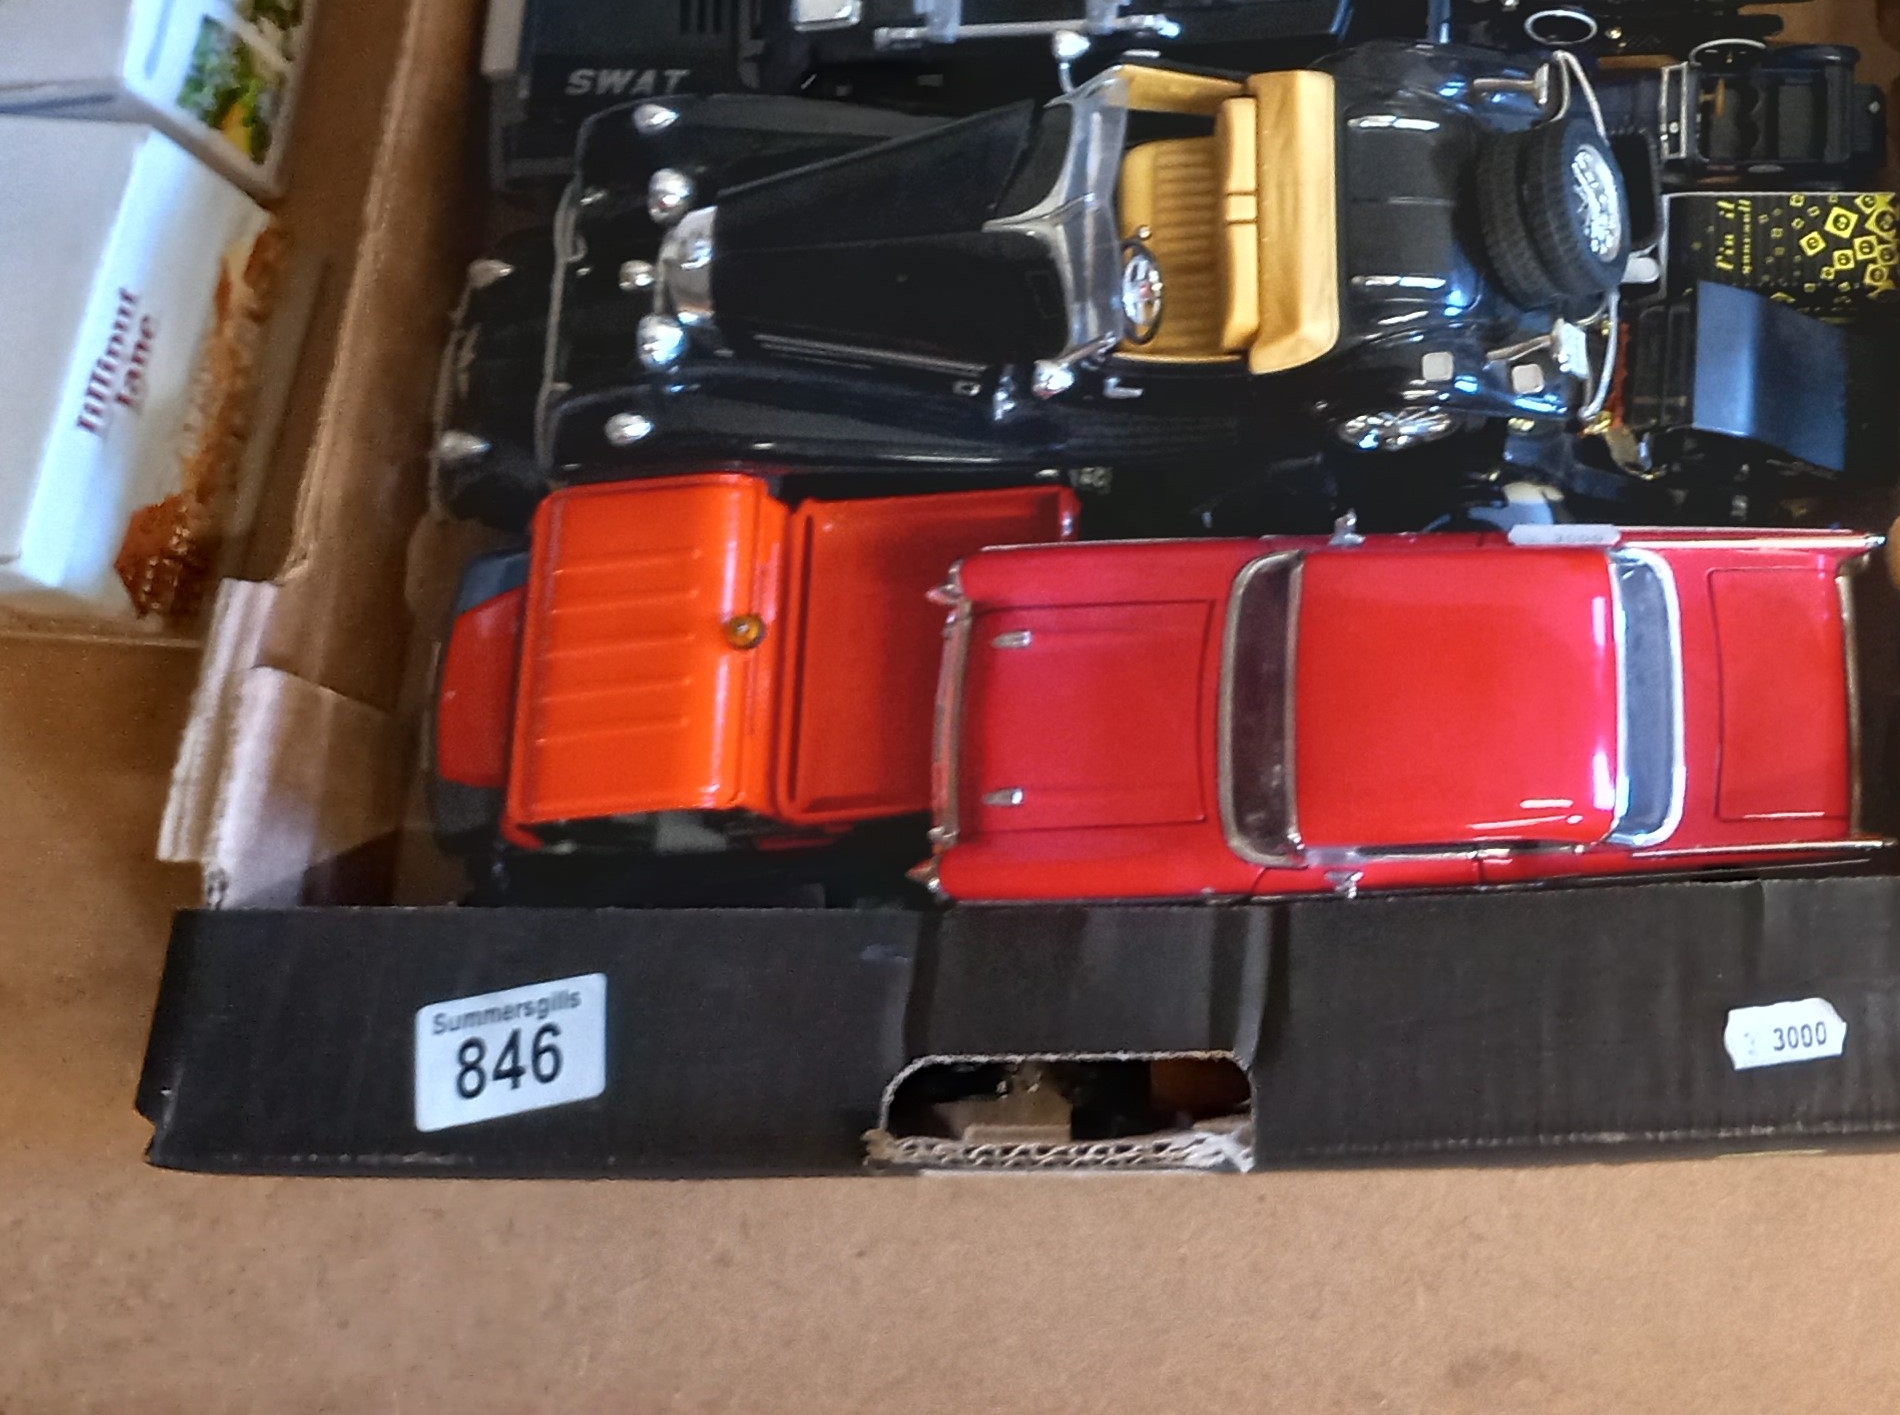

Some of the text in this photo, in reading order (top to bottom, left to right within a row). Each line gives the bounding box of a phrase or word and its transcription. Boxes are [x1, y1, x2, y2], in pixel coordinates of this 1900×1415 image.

[565, 68, 690, 96] SWAT
[432, 988, 583, 1036] Summersgills
[1773, 1020, 1828, 1052] 3000
[456, 1022, 564, 1100] 846
